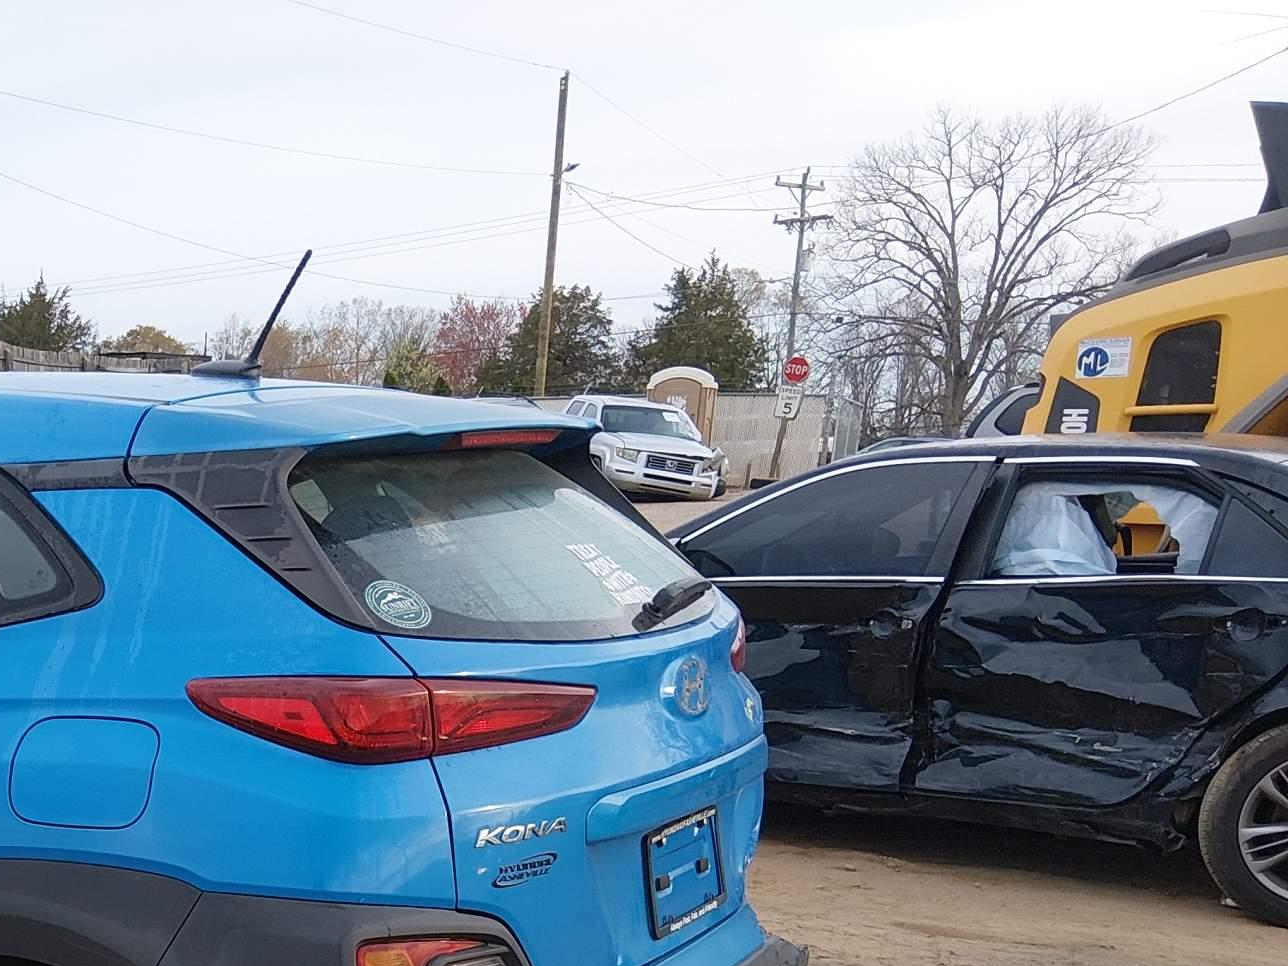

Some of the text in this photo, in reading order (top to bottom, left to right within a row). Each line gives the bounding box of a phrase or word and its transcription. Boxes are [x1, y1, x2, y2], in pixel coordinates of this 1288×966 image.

[785, 363, 808, 375] STOP
[782, 402, 792, 415] 5
[474, 816, 568, 848] KONA
[498, 858, 552, 875] HYUNDAI
[497, 867, 552, 883] ASHEVILLE
